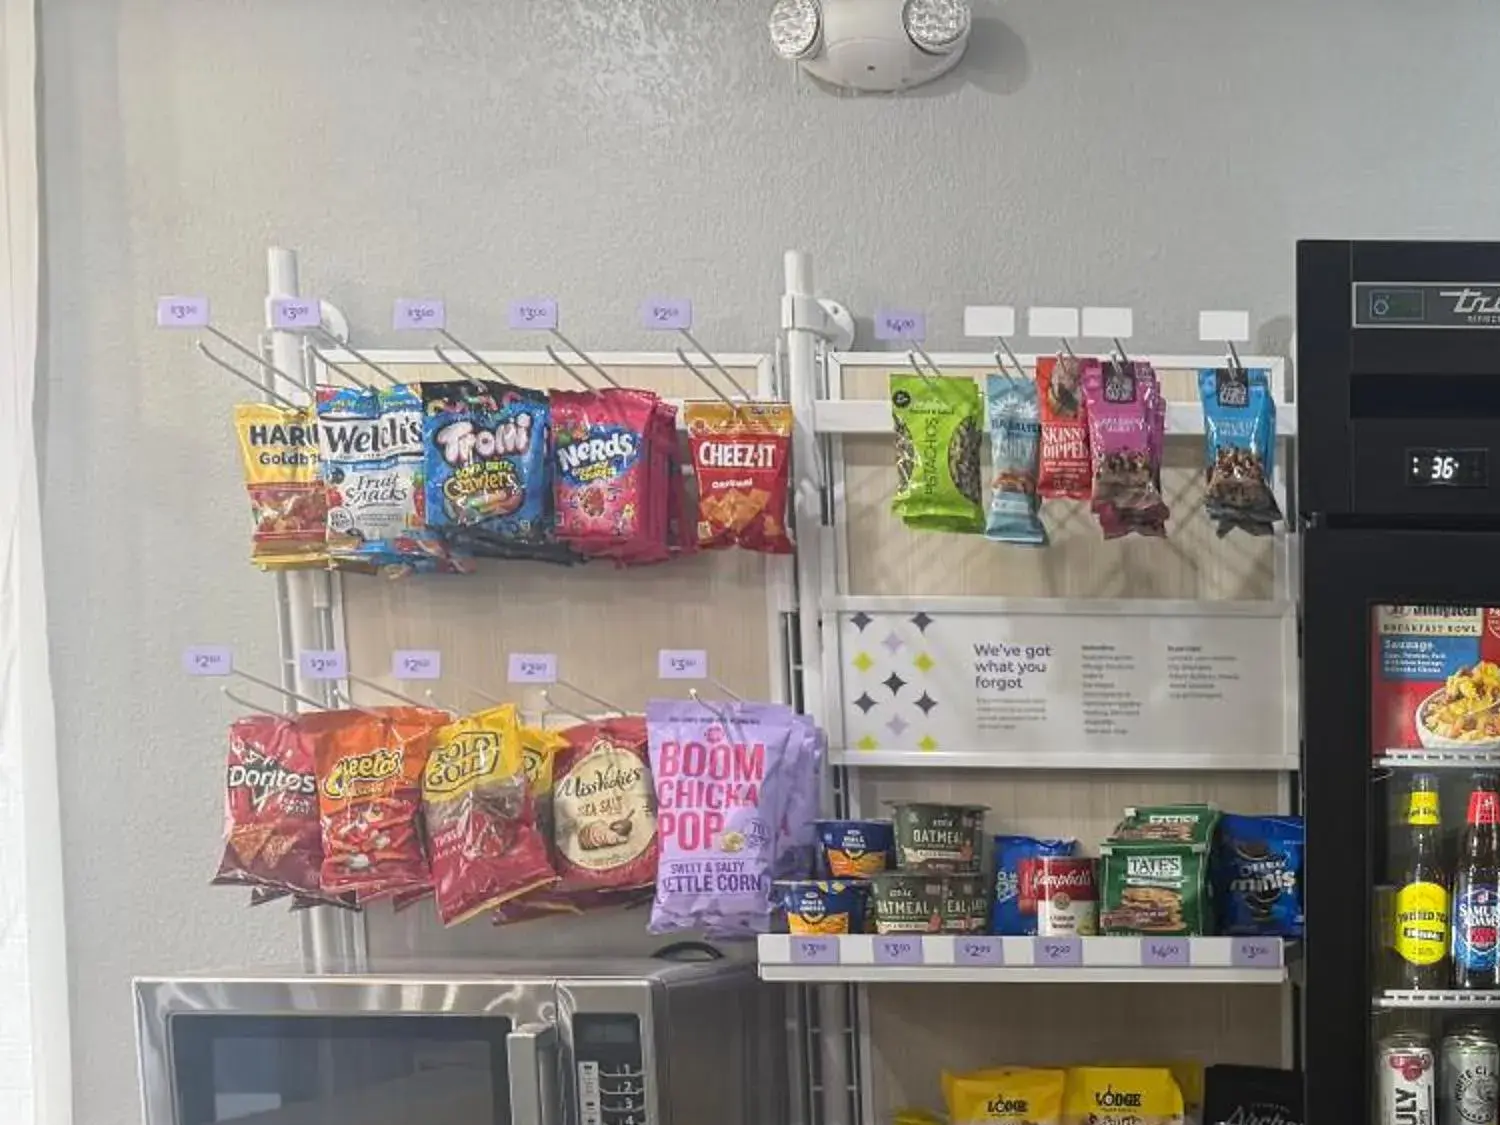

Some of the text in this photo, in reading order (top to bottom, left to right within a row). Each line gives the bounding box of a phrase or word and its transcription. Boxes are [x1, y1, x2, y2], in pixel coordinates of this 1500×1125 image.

[250, 424, 319, 447] HARI
[323, 415, 422, 453] Welch's
[259, 452, 320, 466] Goldb
[1025, 644, 1053, 660] got
[975, 659, 1047, 675] what you
[975, 675, 1024, 691] forgot
[659, 741, 765, 782] BOOM
[229, 765, 315, 793] Doritos
[658, 779, 758, 809] CHICKA
[657, 810, 725, 852] POP
[718, 874, 762, 893] CORN
